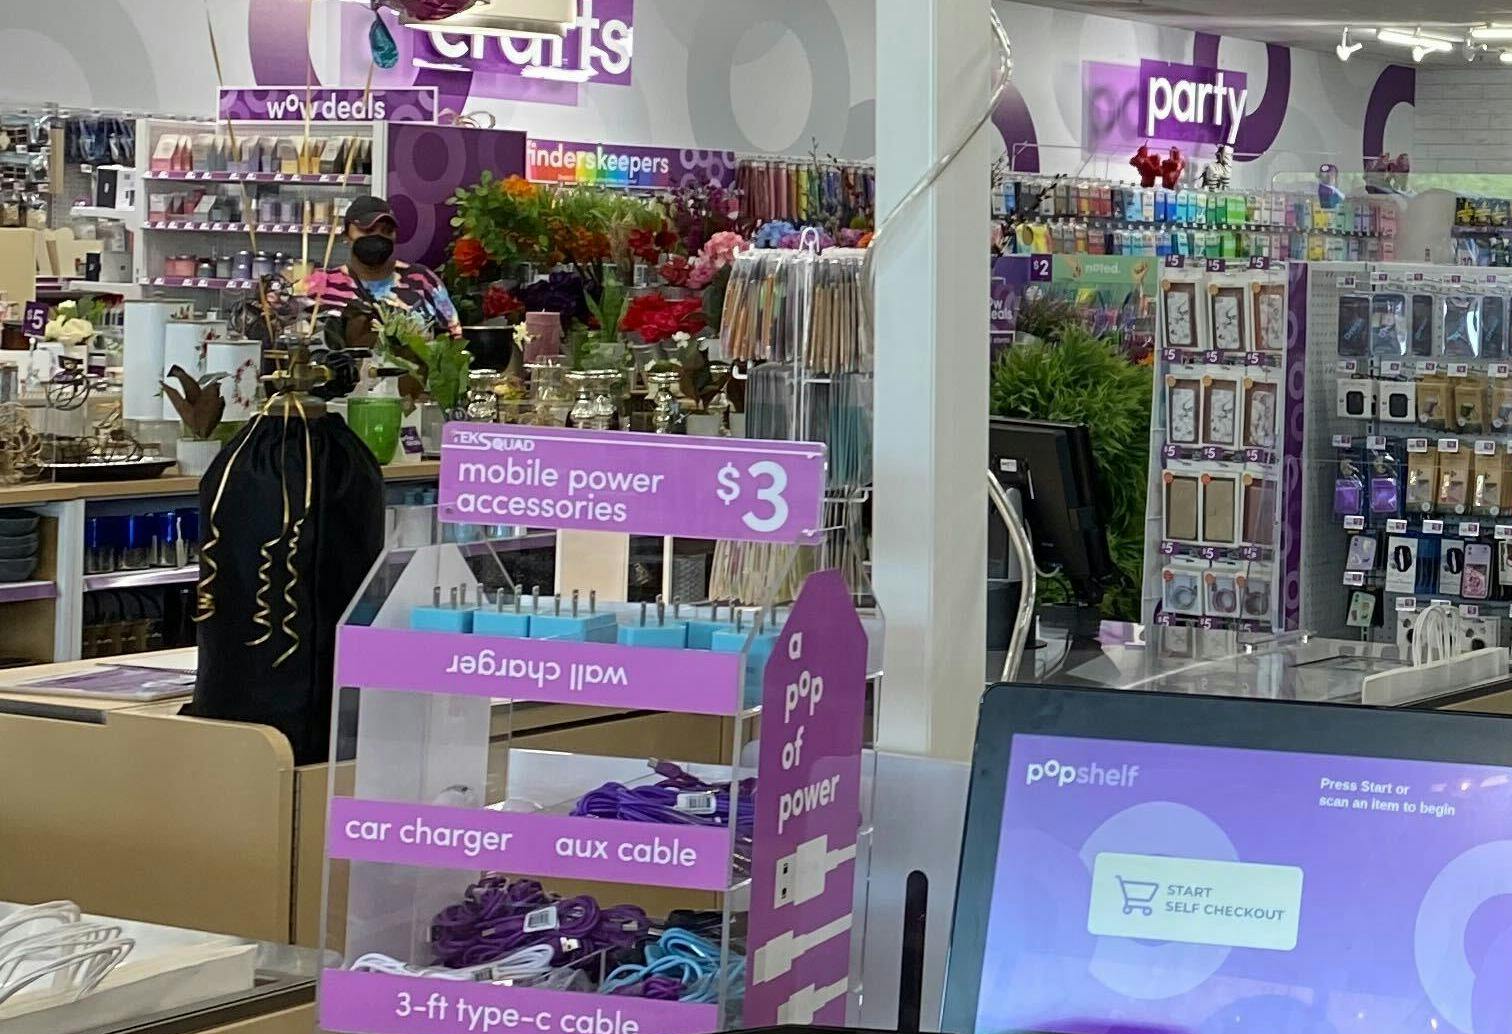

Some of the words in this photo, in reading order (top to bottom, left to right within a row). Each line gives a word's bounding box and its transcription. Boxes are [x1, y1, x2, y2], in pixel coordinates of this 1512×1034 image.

[267, 93, 320, 120] wow
[321, 94, 386, 120] deals
[1146, 72, 1248, 144] party
[1033, 260, 1049, 276] $2
[1168, 255, 1179, 266] $5
[1208, 260, 1220, 271] $5
[1252, 257, 1264, 268] $5
[26, 308, 43, 330] $5
[1164, 349, 1176, 360] $5
[1206, 351, 1218, 362] $5
[1247, 353, 1259, 364] $5
[1164, 445, 1175, 457] $5
[1204, 447, 1216, 459] $5
[1246, 450, 1258, 461] $5
[458, 457, 559, 487] mobile
[568, 468, 664, 496] power
[716, 461, 789, 533] $3
[456, 493, 628, 522] accessories
[1162, 542, 1173, 554] $5
[1202, 547, 1214, 559] $5
[1201, 618, 1212, 629] $5
[788, 632, 803, 660] a
[446, 649, 561, 688] charger
[569, 664, 628, 691] wall
[784, 670, 824, 724] pop
[781, 725, 804, 770] of
[1025, 759, 1140, 787] popshelf
[1320, 777, 1358, 792] Press
[1360, 780, 1393, 795] Start
[1395, 785, 1410, 796] or
[778, 773, 840, 835] power
[1319, 795, 1349, 808] scan
[1352, 799, 1368, 810] an
[1371, 797, 1400, 812] item
[1403, 801, 1417, 813] to
[1420, 801, 1456, 818] begin
[344, 819, 392, 842] car
[399, 818, 513, 856] charger
[555, 835, 609, 860] aux
[617, 836, 697, 867] cable
[1167, 884, 1213, 898] START
[1165, 900, 1200, 914] SELF
[1203, 903, 1287, 921] CHECKOUT
[395, 992, 449, 1020] 3-ft
[456, 998, 552, 1033] type-c
